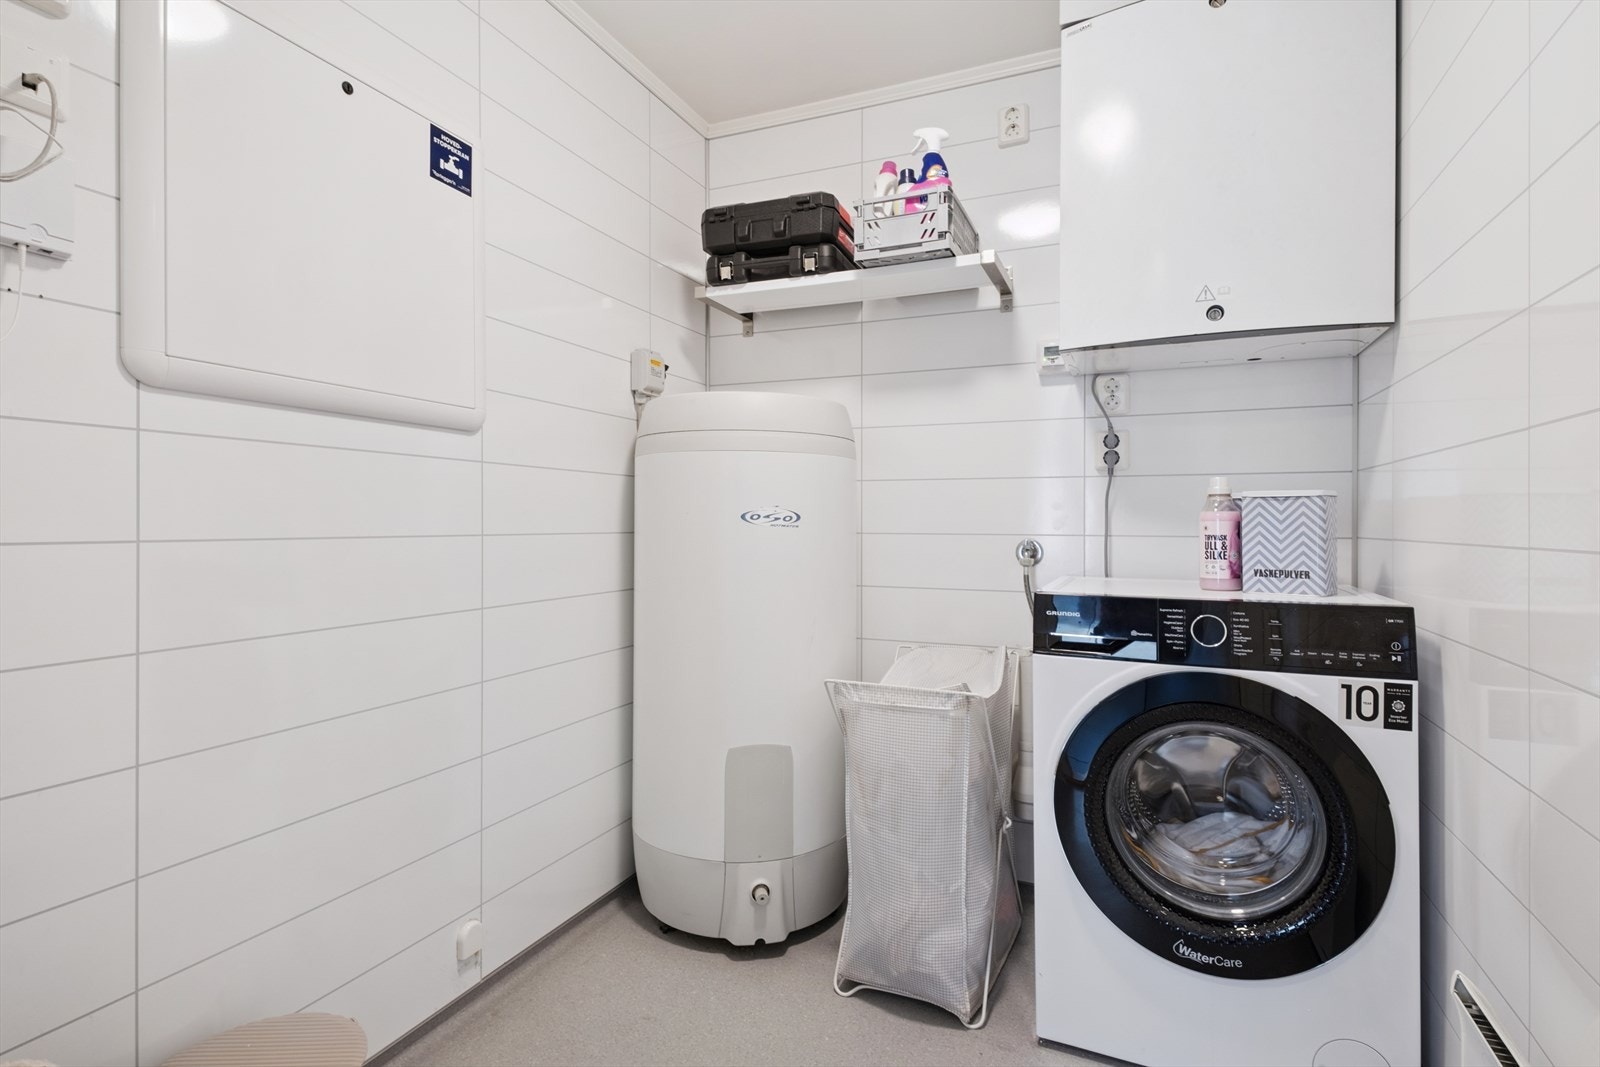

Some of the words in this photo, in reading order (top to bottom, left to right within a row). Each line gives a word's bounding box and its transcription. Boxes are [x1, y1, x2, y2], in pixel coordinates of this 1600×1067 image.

[433, 136, 470, 160] STOPPEKRAN
[1204, 541, 1218, 551] ULL
[1220, 541, 1228, 551] &
[1204, 550, 1228, 560] SILKE
[1253, 568, 1311, 580] VASKEPULVER
[1045, 610, 1081, 618] GRUNDIG
[1341, 684, 1380, 722] 10
[1179, 944, 1243, 968] WaterCare
